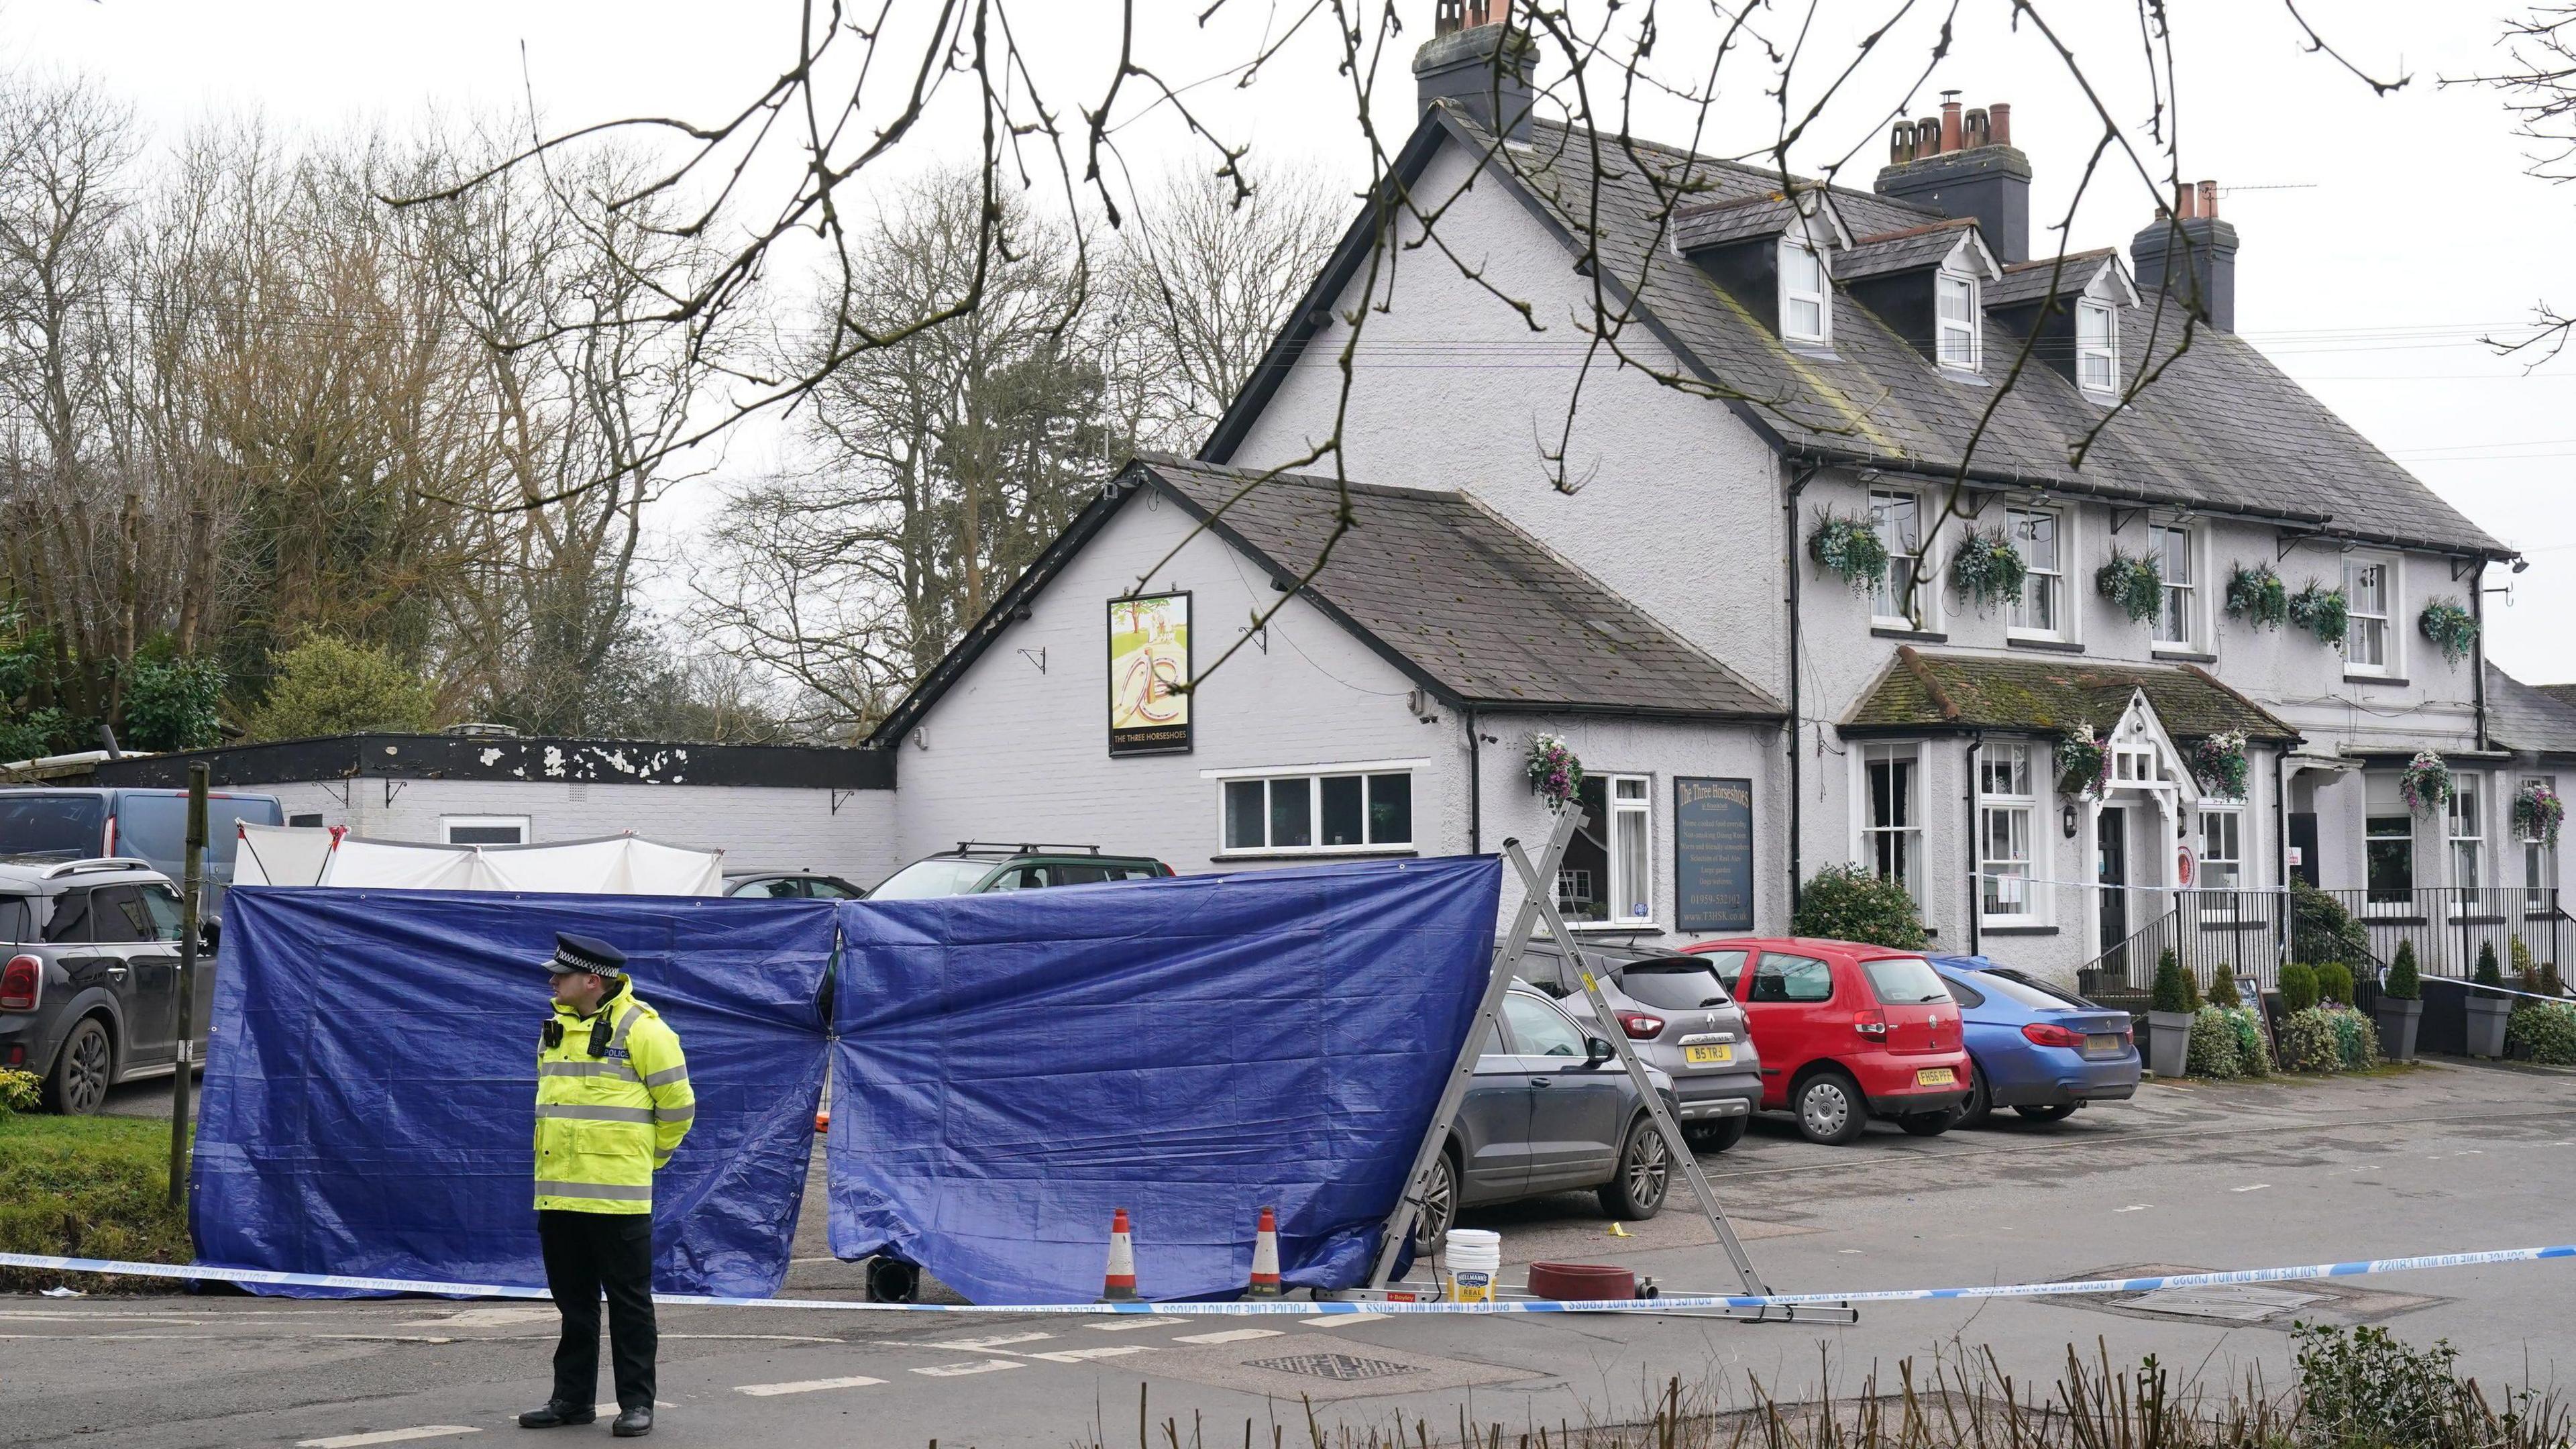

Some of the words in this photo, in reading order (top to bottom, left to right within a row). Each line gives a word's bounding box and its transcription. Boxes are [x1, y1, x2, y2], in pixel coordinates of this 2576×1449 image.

[1127, 733, 1145, 742] THREE
[1146, 731, 1187, 741] HORSESHOES
[1680, 784, 1692, 806] The
[1693, 784, 1711, 800] Three
[1713, 784, 1749, 808] Horseshoes
[1684, 911, 1748, 921] www.T3HSK.co.uk
[604, 1049, 629, 1058] POLICE
[1695, 1048, 1707, 1059] B5
[1707, 1046, 1723, 1059] TRJ
[1458, 1274, 1487, 1282] HELLMANN'S
